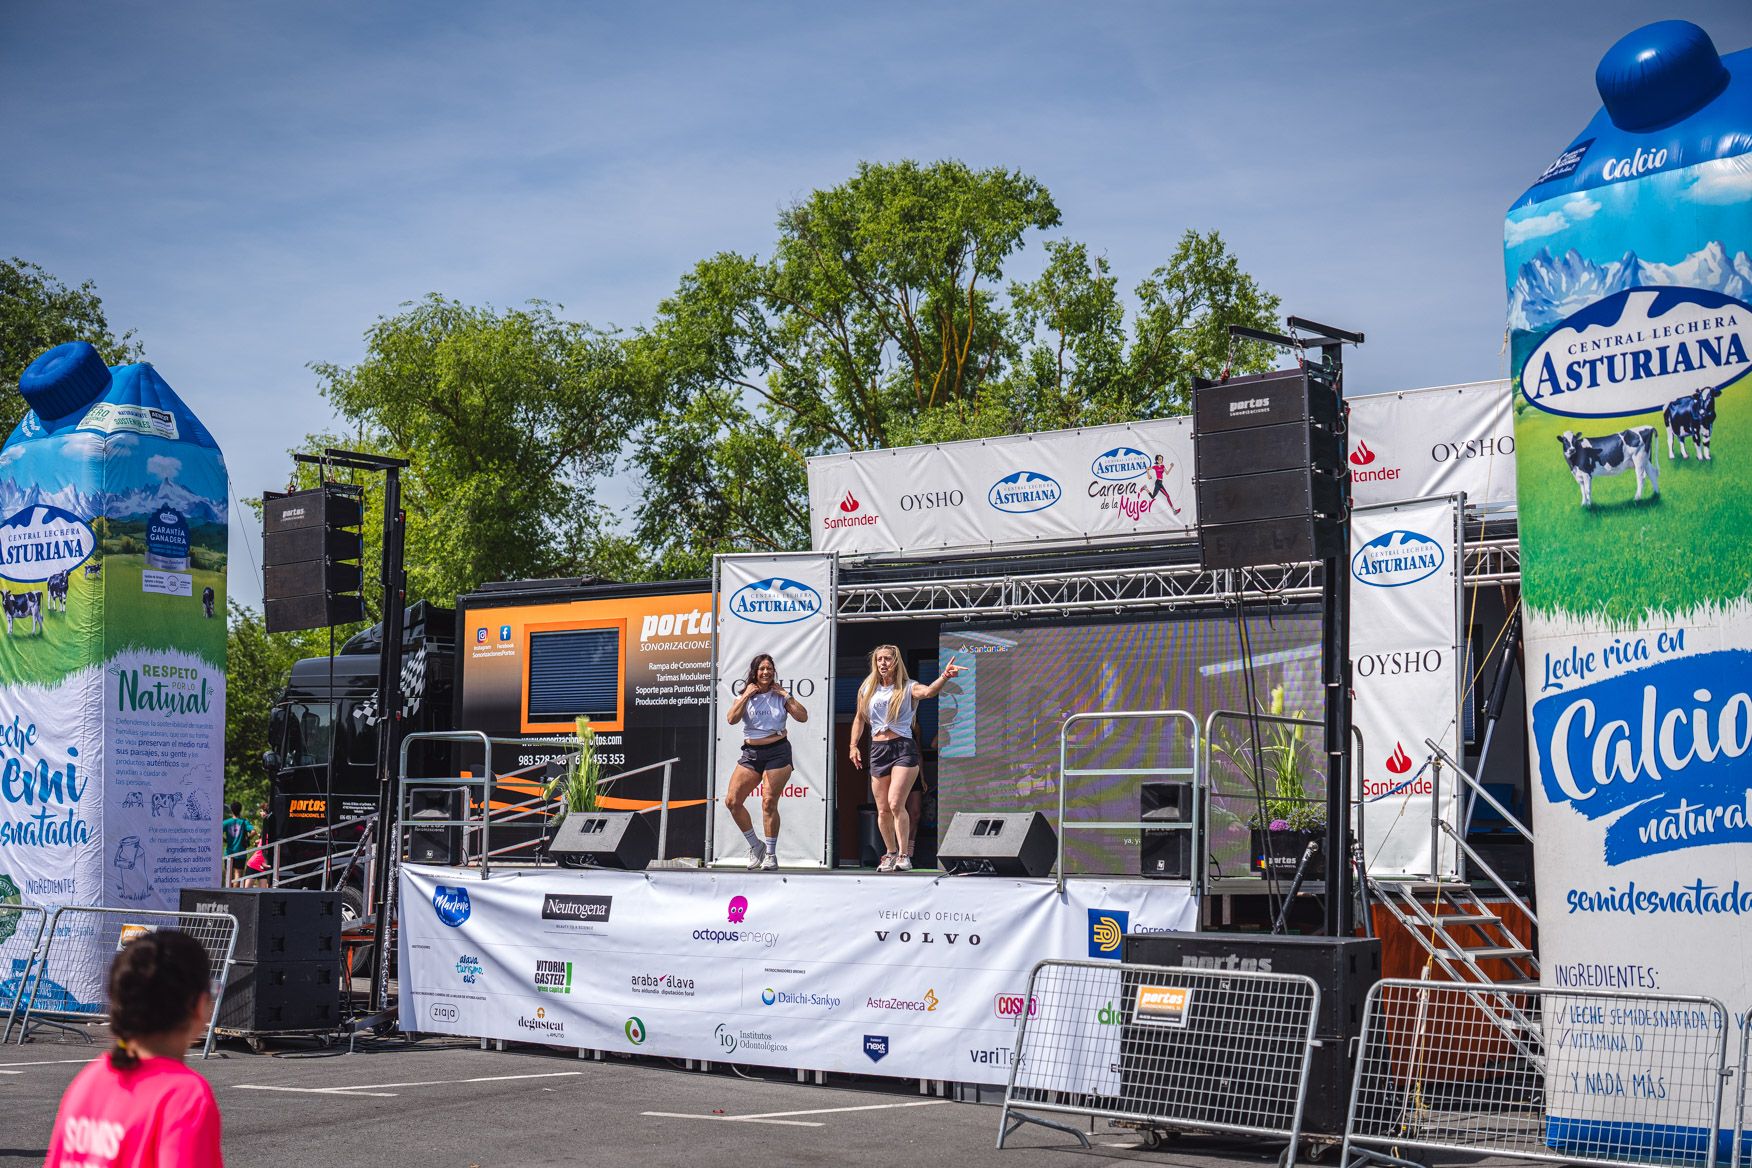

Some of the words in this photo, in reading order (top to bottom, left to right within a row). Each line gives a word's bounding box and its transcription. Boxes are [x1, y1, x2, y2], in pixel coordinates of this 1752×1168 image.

[1568, 331, 1644, 356] CENTRAL
[1653, 315, 1738, 338] LECHERA
[1533, 332, 1750, 399] ASTURIANA
[1230, 398, 1269, 412] portos
[1432, 436, 1514, 462] OYSHO
[1097, 461, 1147, 474] ASTURIANA
[1350, 467, 1400, 483] tander
[995, 489, 1056, 504] ASTURIANA
[1088, 481, 1136, 497] Carrera
[900, 490, 964, 511] OYSHO
[1101, 498, 1109, 509] de
[1112, 498, 1118, 508] la
[1118, 493, 1156, 521] Mujer
[824, 514, 879, 529] Santander
[9, 532, 40, 542] CENTRAL
[44, 528, 81, 537] LECHERA
[152, 526, 185, 536] GARANTÍA
[150, 534, 186, 544] GANADERA
[1403, 546, 1433, 554] LECHERA
[1358, 554, 1436, 576] ASTURIANA
[736, 595, 814, 612] ASTURIANA
[640, 641, 712, 652] SONORIZACIONE
[649, 662, 669, 671] Rampa
[670, 662, 678, 670] de
[1357, 649, 1441, 677] OYSHO
[1541, 645, 1597, 692] Leche
[1603, 637, 1650, 668] rica
[1657, 628, 1685, 652] en
[143, 664, 198, 680] RESPETO
[680, 673, 711, 681] Modulares
[119, 670, 210, 714] Natural
[172, 682, 186, 690] POR
[636, 686, 658, 695] Soporte
[732, 679, 814, 697] OHO
[636, 697, 668, 705] Producción
[677, 696, 697, 706] gráfica
[0, 715, 39, 755] eche
[1551, 684, 1752, 800] Calcio
[138, 740, 170, 748] preservan
[130, 749, 159, 757] paisajes,
[519, 755, 533, 766] 983
[609, 754, 625, 764] 353
[0, 746, 88, 805] emi
[1363, 777, 1432, 796] Santande
[290, 799, 326, 813] portos
[26, 878, 78, 895] INGREDIENTES:
[435, 894, 469, 916] Marlene
[547, 898, 607, 918] Neutrogena
[879, 909, 930, 920] VEHÍCULO
[936, 912, 976, 922] OFICIAL
[875, 931, 981, 945] VOLVO
[536, 960, 565, 973] VITORIA
[535, 973, 565, 985] GASTEIZ
[632, 974, 658, 986] araba
[666, 975, 694, 989] álava
[1555, 964, 1660, 989] INGREDIENTES:
[778, 992, 840, 1010] Daiichi-Sankyo
[866, 997, 925, 1011] AstraZeneca
[1142, 992, 1183, 1005] portos
[435, 1008, 455, 1020] ziaja
[1570, 1005, 1604, 1025] LECHE
[1610, 1008, 1708, 1029] SEMIDESNATADA
[740, 1030, 772, 1041] Institutos
[1571, 1032, 1627, 1050] VITAMINA
[1635, 1035, 1643, 1052] D
[740, 1040, 788, 1052] Odontológicos
[1586, 1073, 1625, 1097] NADA
[1633, 1070, 1666, 1099] MÁS
